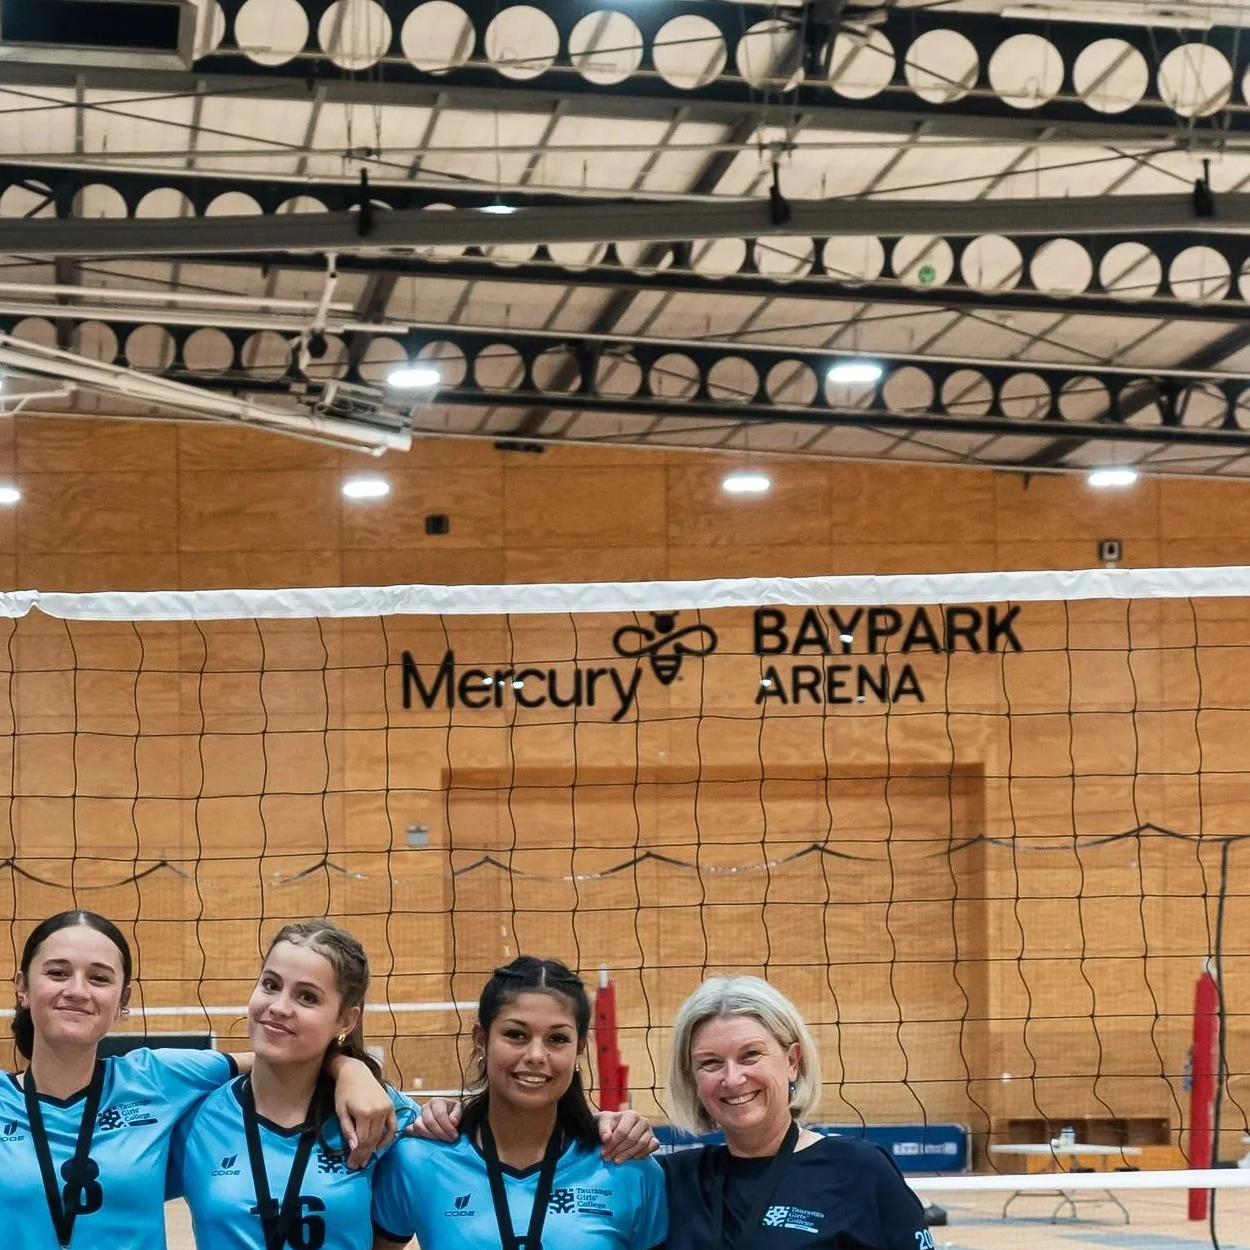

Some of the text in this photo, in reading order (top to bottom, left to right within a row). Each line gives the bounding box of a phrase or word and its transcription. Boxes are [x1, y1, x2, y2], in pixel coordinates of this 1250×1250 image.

[754, 606, 1022, 655] BAYPARK
[401, 650, 642, 720] Mercury
[756, 665, 924, 704] ARENA
[61, 1157, 104, 1215] 8
[577, 1201, 607, 1209] College
[444, 1210, 475, 1218] CODE
